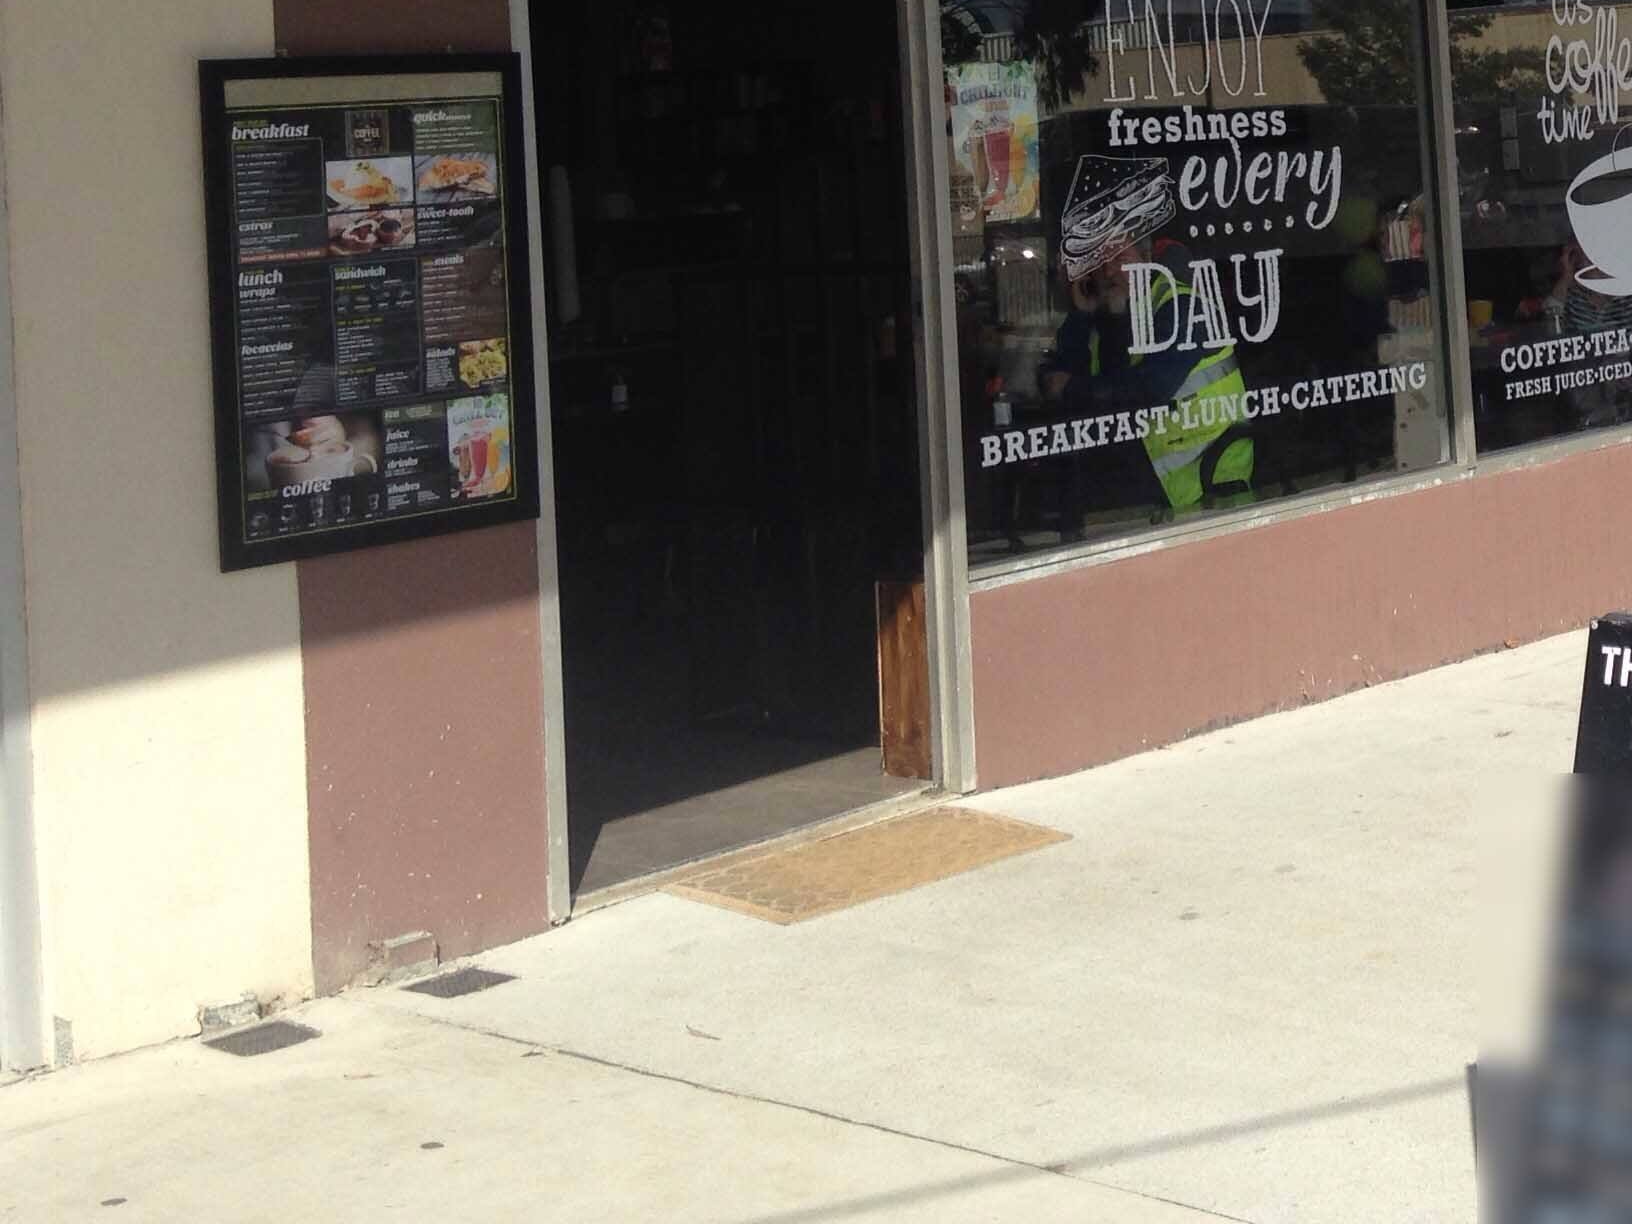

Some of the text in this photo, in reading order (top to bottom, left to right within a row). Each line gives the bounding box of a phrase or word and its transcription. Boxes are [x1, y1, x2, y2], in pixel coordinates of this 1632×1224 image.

[232, 123, 309, 140] breakfast
[1108, 105, 1287, 147] freshness
[1537, 95, 1595, 144] time
[1179, 137, 1341, 230] every
[238, 268, 283, 286] lunch
[1122, 249, 1284, 354] DAY
[1501, 336, 1586, 373] COFFEE
[1590, 329, 1630, 358] TEA
[1505, 377, 1553, 401] FRESH
[1555, 369, 1594, 396] JUICE
[1599, 360, 1632, 383] ICED
[980, 361, 1427, 468] BREAKFAST LUNCH CATERING
[282, 479, 333, 497] coffee
